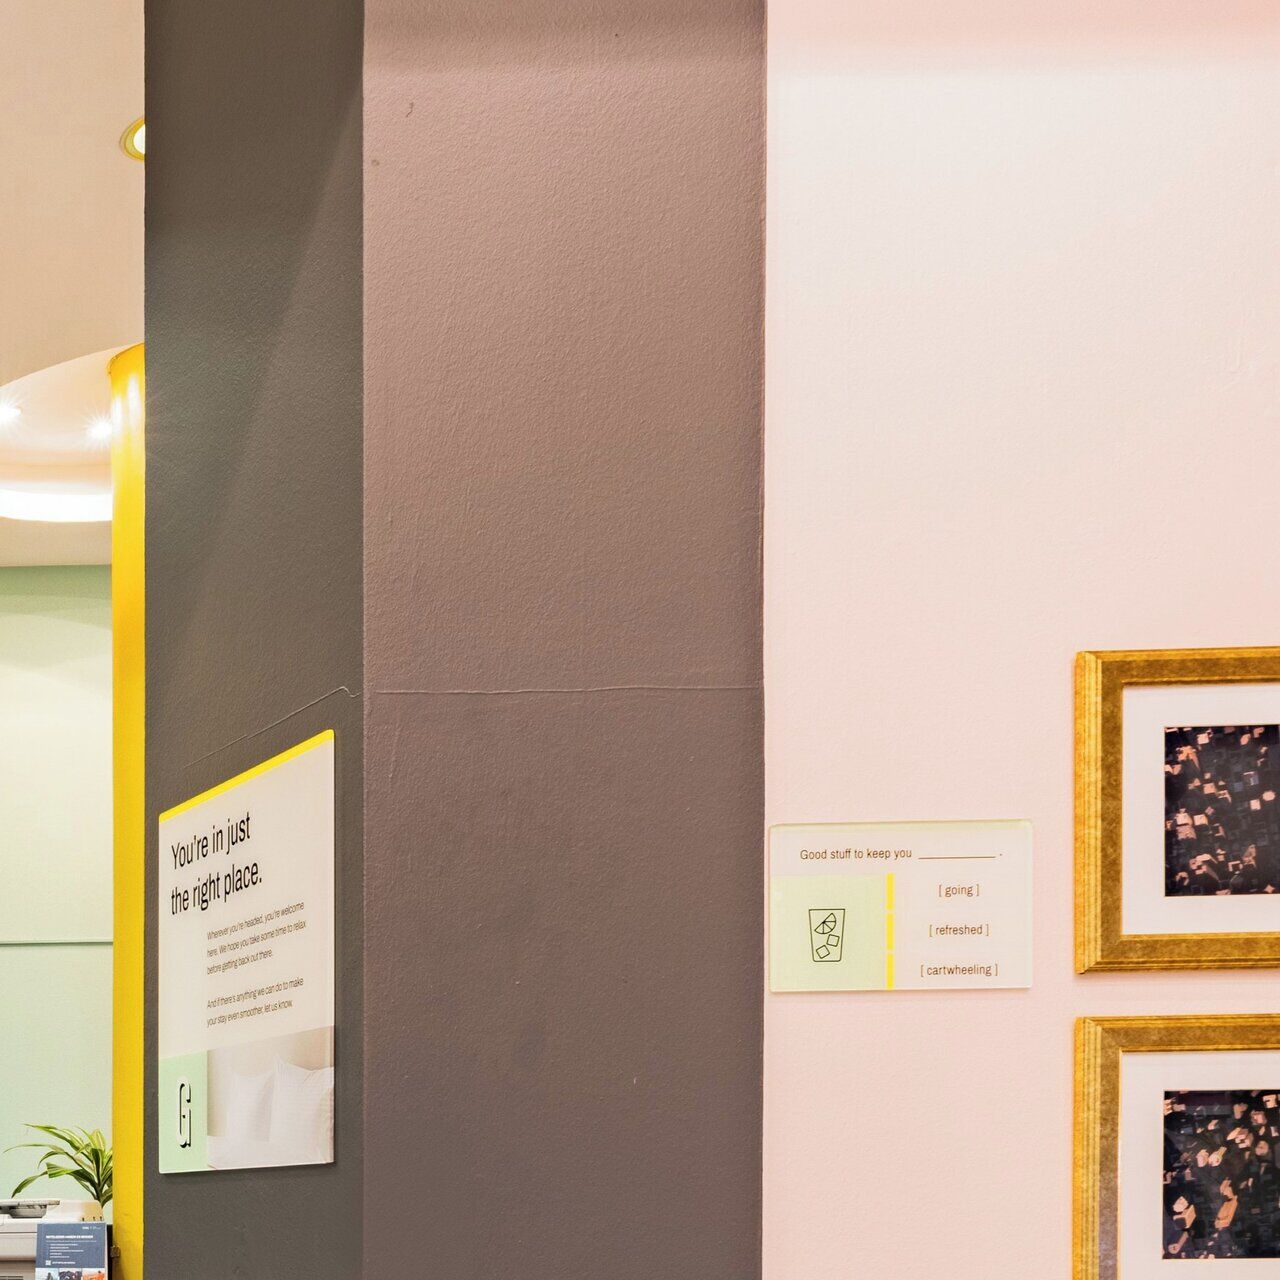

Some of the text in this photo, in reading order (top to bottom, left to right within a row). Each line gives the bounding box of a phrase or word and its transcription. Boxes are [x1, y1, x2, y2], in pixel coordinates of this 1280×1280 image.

[171, 811, 251, 870] You're in just
[800, 848, 912, 860] Good stuff to keep you
[171, 862, 262, 915] the right place.
[281, 901, 304, 916] welcome
[293, 919, 307, 932] relax
[289, 977, 304, 988] make
[176, 1075, 192, 1148] G
